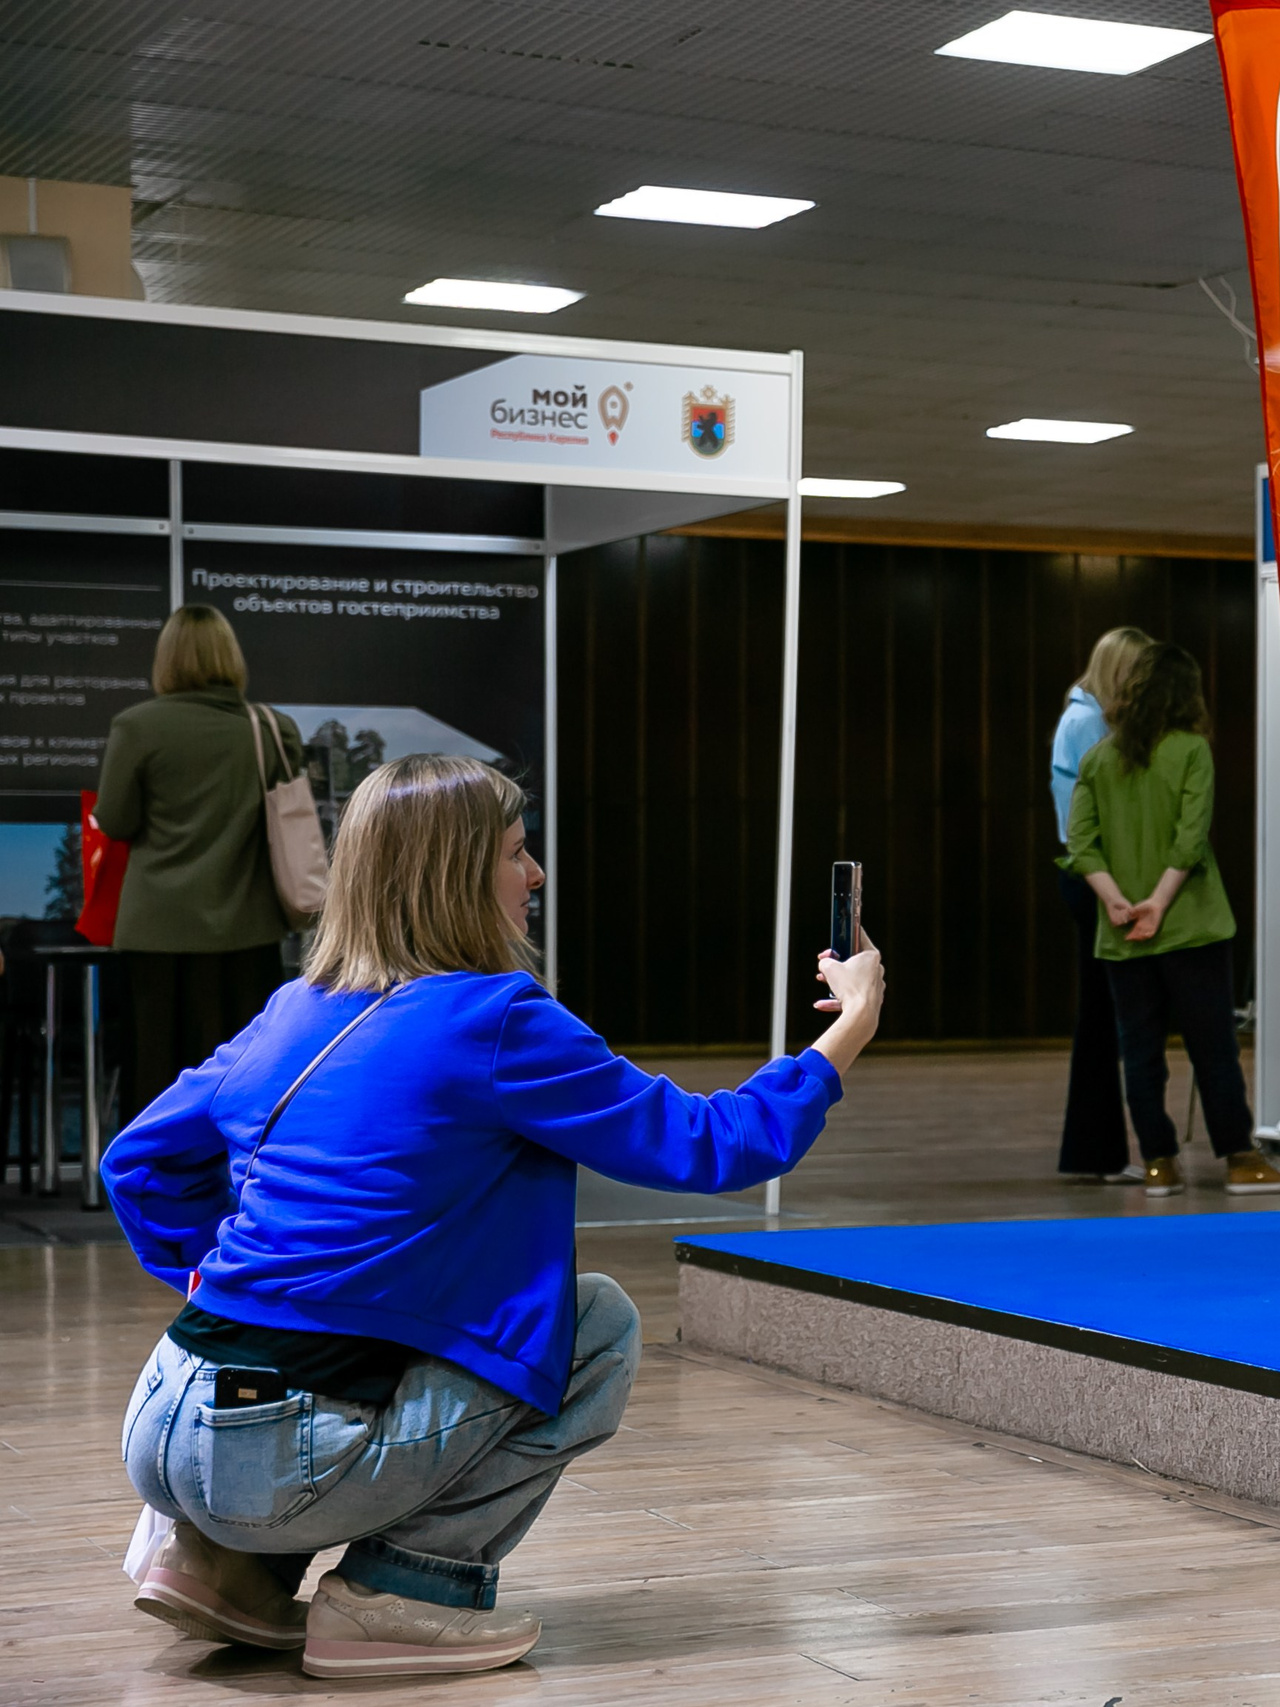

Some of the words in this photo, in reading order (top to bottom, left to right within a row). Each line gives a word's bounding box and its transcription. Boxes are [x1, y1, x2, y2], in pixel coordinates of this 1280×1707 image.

[490, 398, 588, 430] бизнес
[192, 568, 370, 592] Проектирование
[374, 579, 387, 592] и
[391, 579, 539, 598] строительство
[233, 593, 333, 614] объектов
[337, 599, 500, 620] гостеприимства
